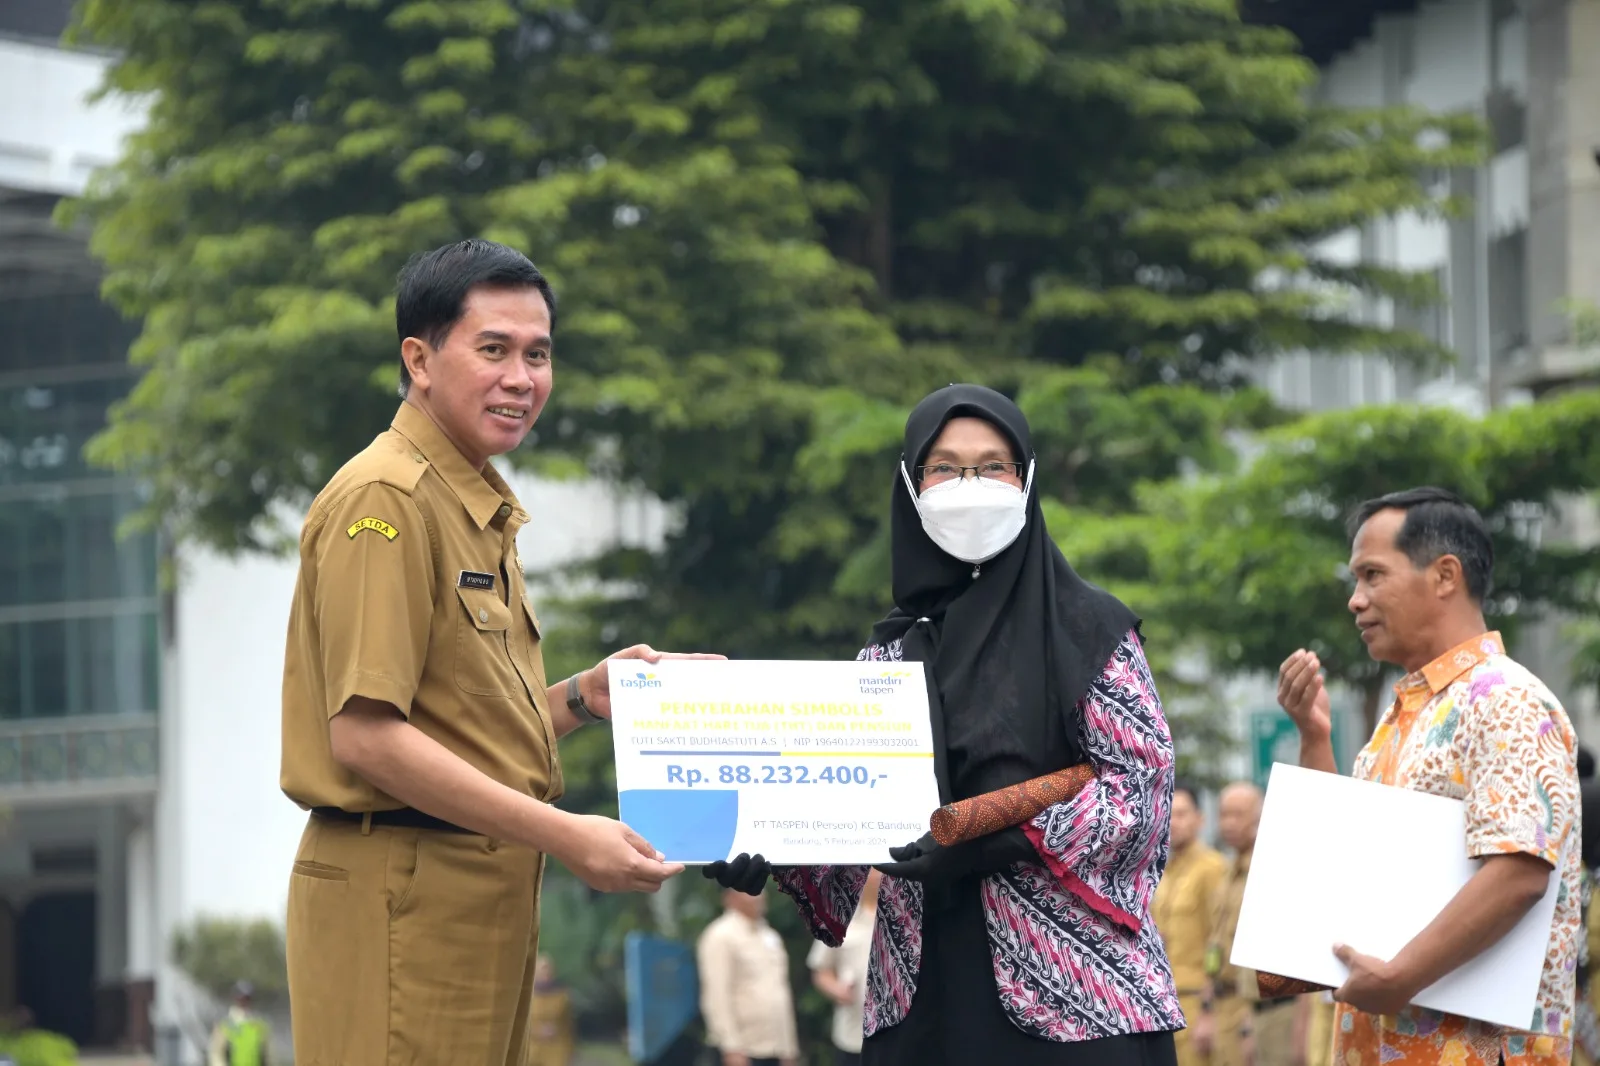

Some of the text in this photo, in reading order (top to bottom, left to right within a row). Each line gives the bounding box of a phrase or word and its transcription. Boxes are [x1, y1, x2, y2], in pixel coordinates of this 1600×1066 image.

[355, 520, 389, 533] SETDA
[620, 678, 662, 689] taspen
[859, 676, 902, 685] mandiri
[860, 686, 894, 695] taspen
[660, 702, 883, 716] PENYERAHAN SIMBOLIS
[657, 736, 686, 745] SAKTI
[794, 738, 811, 746] NIP
[666, 765, 888, 788] Rp. 88.232.400,-
[754, 821, 922, 831] PT TASPEN (Persero) KC Bandung
